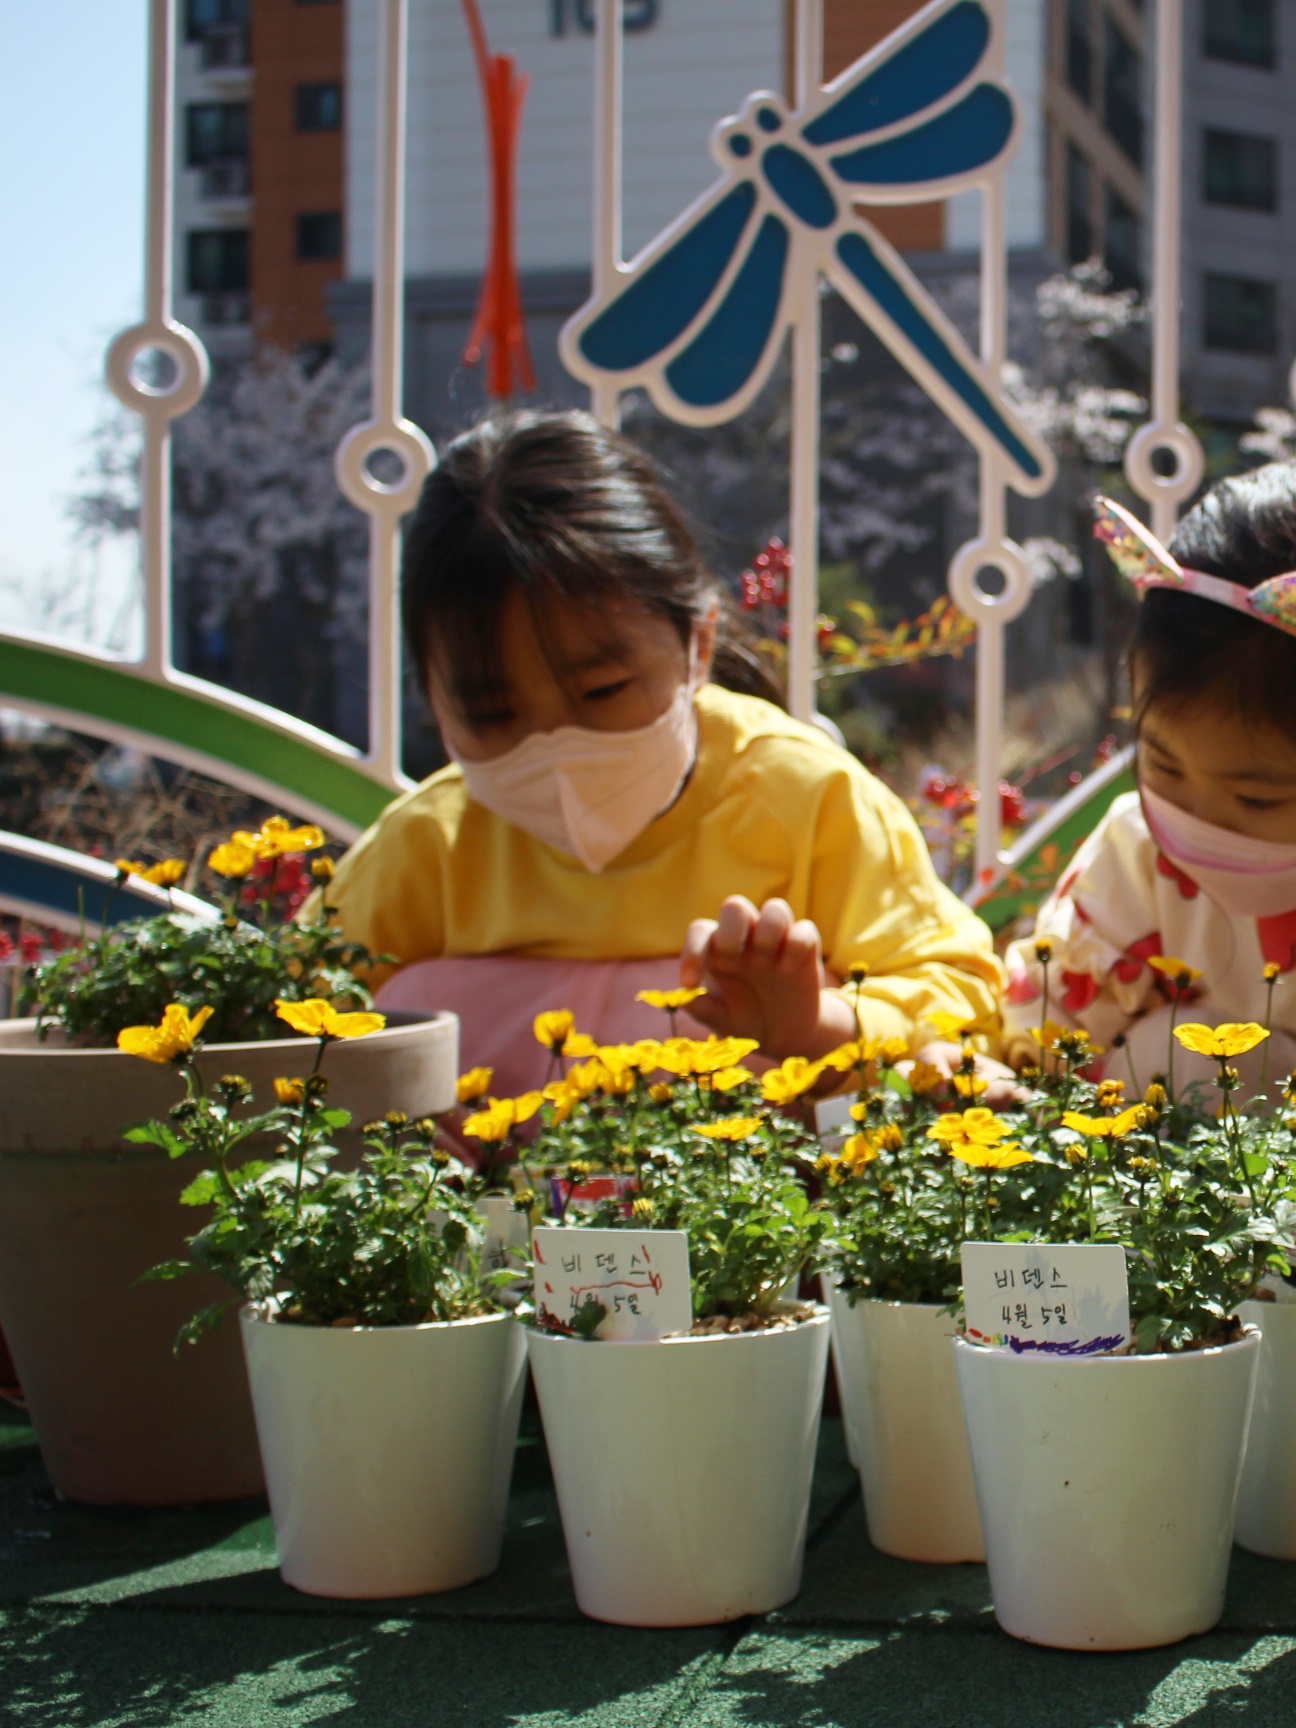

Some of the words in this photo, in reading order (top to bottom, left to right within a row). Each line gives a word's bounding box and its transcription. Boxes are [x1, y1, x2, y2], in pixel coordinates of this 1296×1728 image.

[561, 1253, 646, 1275] 비덴스
[994, 1267, 1067, 1289] 비덴스
[613, 1295, 641, 1316] 5일
[1002, 1303, 1032, 1329] 4월
[1041, 1303, 1068, 1325] 5일
